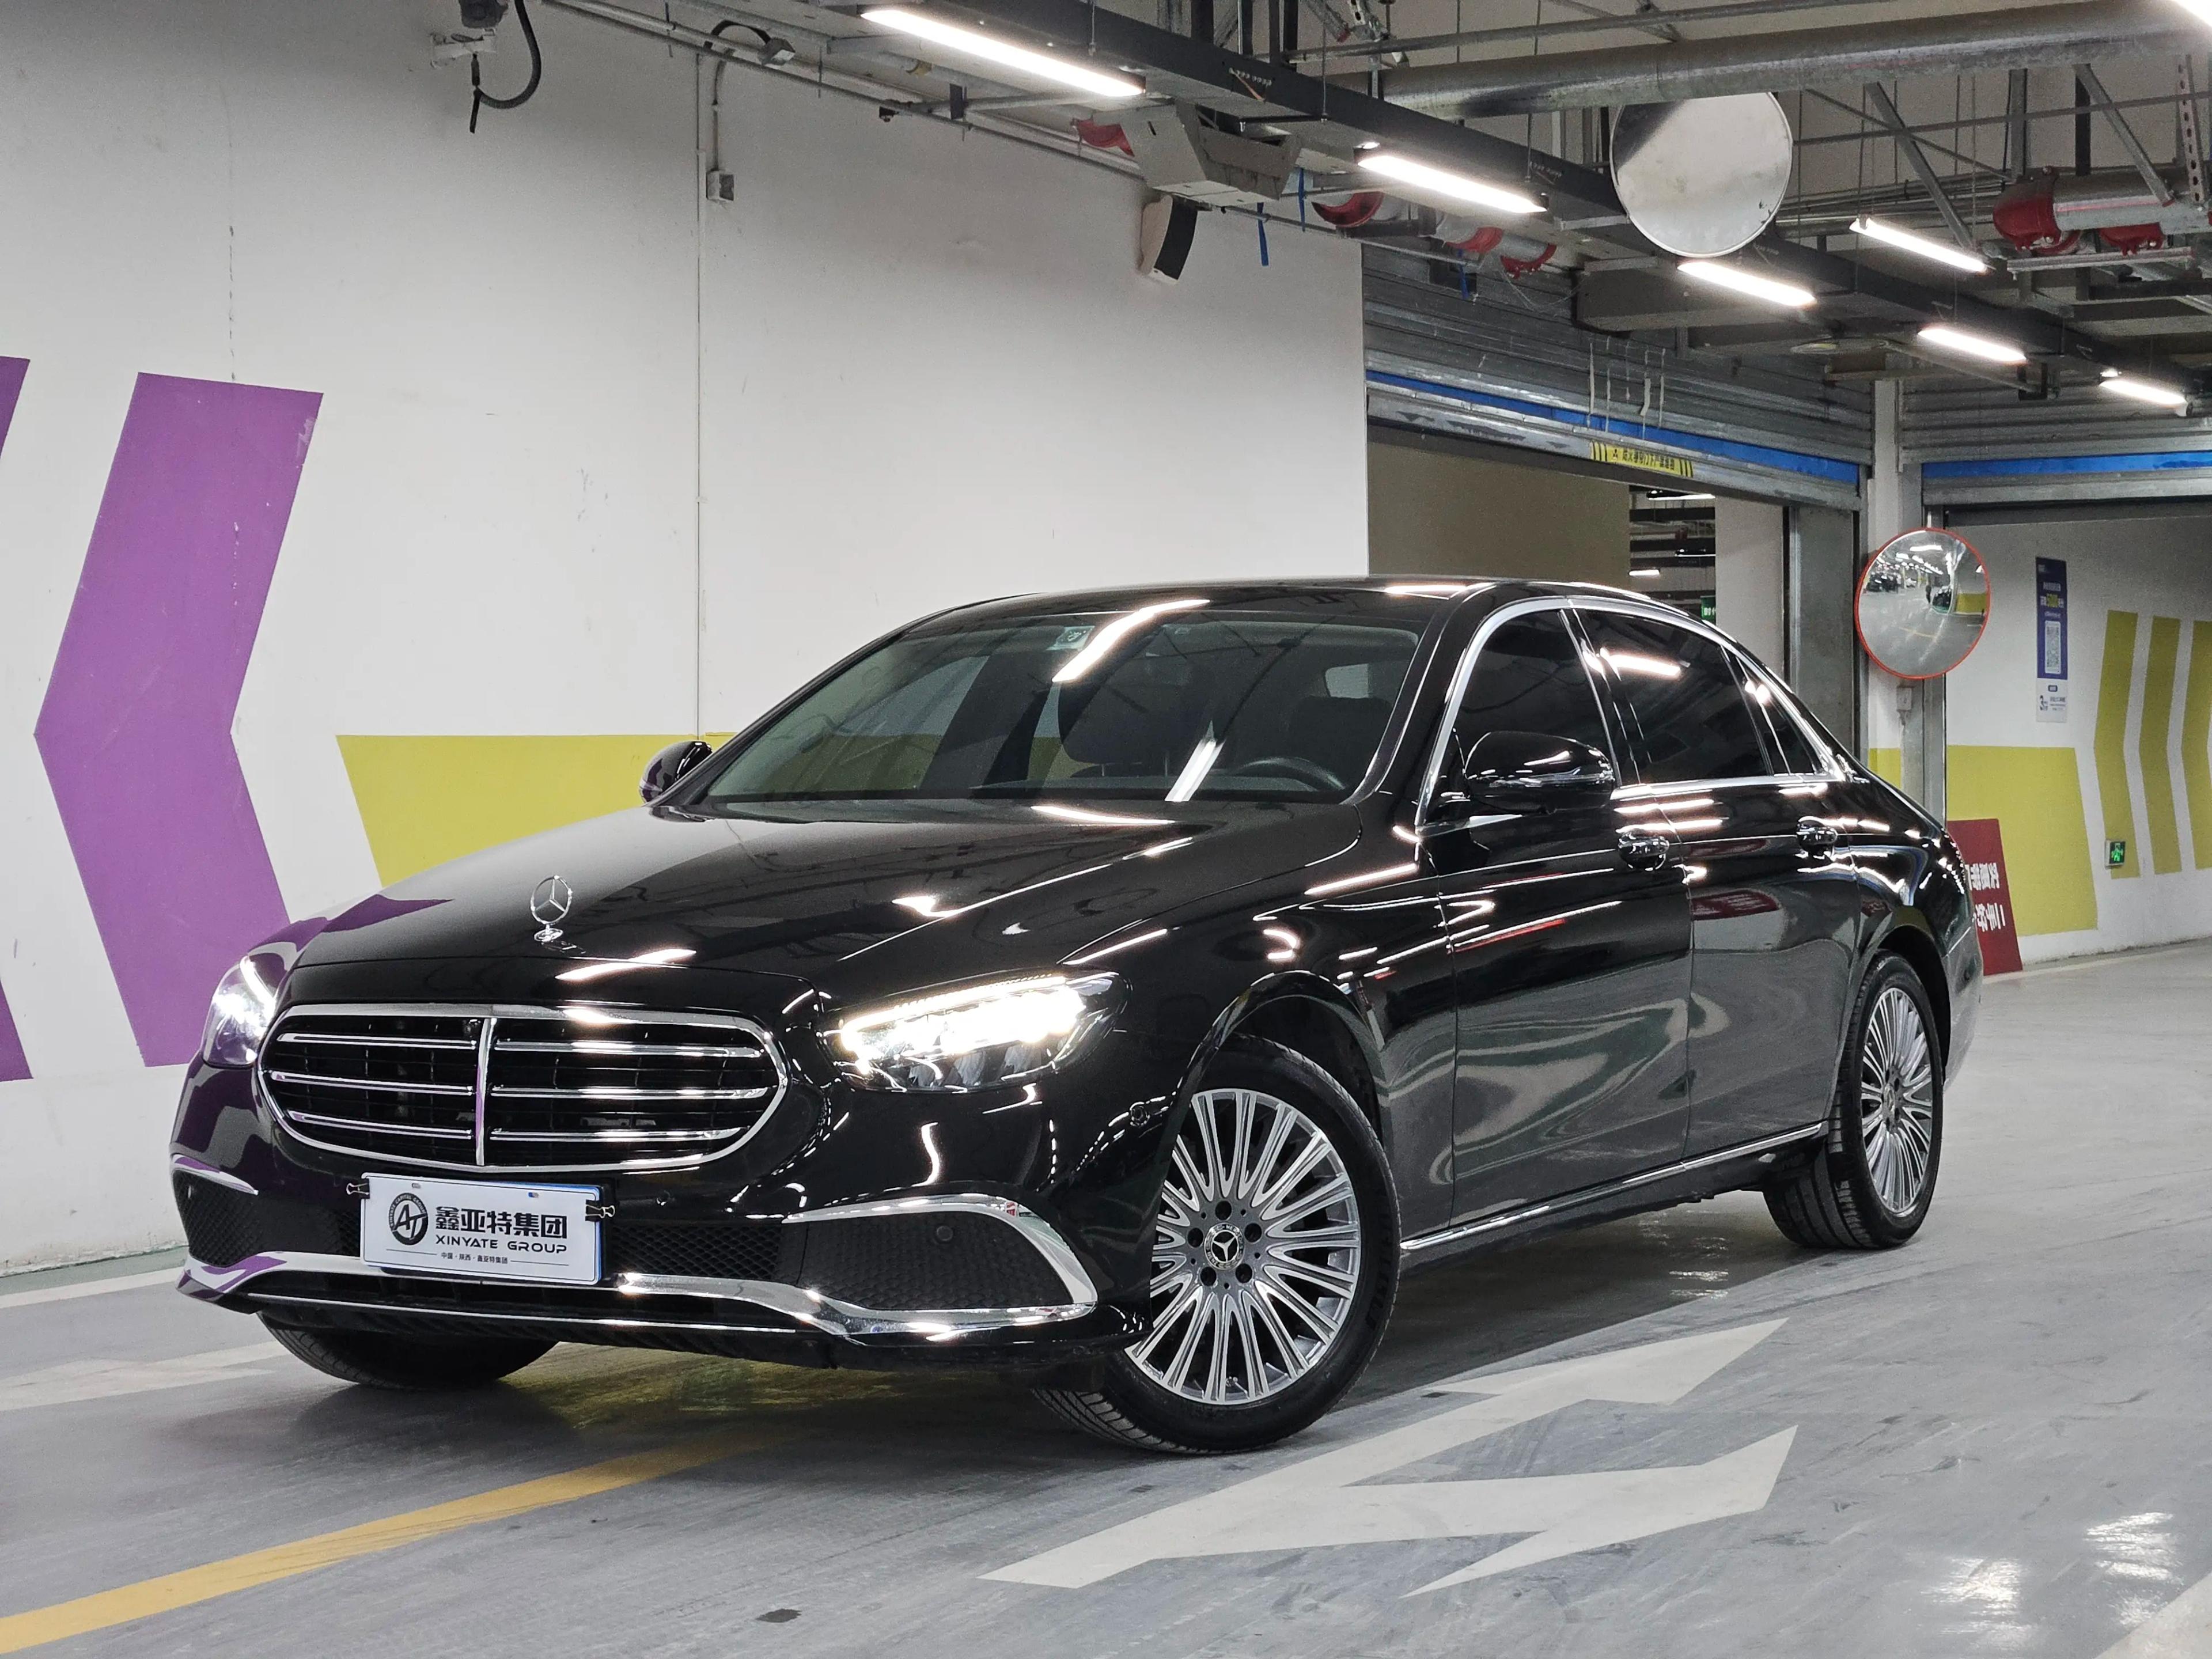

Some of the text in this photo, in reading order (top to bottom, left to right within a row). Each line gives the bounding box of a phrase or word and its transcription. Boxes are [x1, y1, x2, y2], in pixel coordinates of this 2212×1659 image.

[1975, 902, 2006, 932] 二手好
[435, 1206, 567, 1239] 鑫亚特集团
[435, 1235, 567, 1253] XINYATE GROUP
